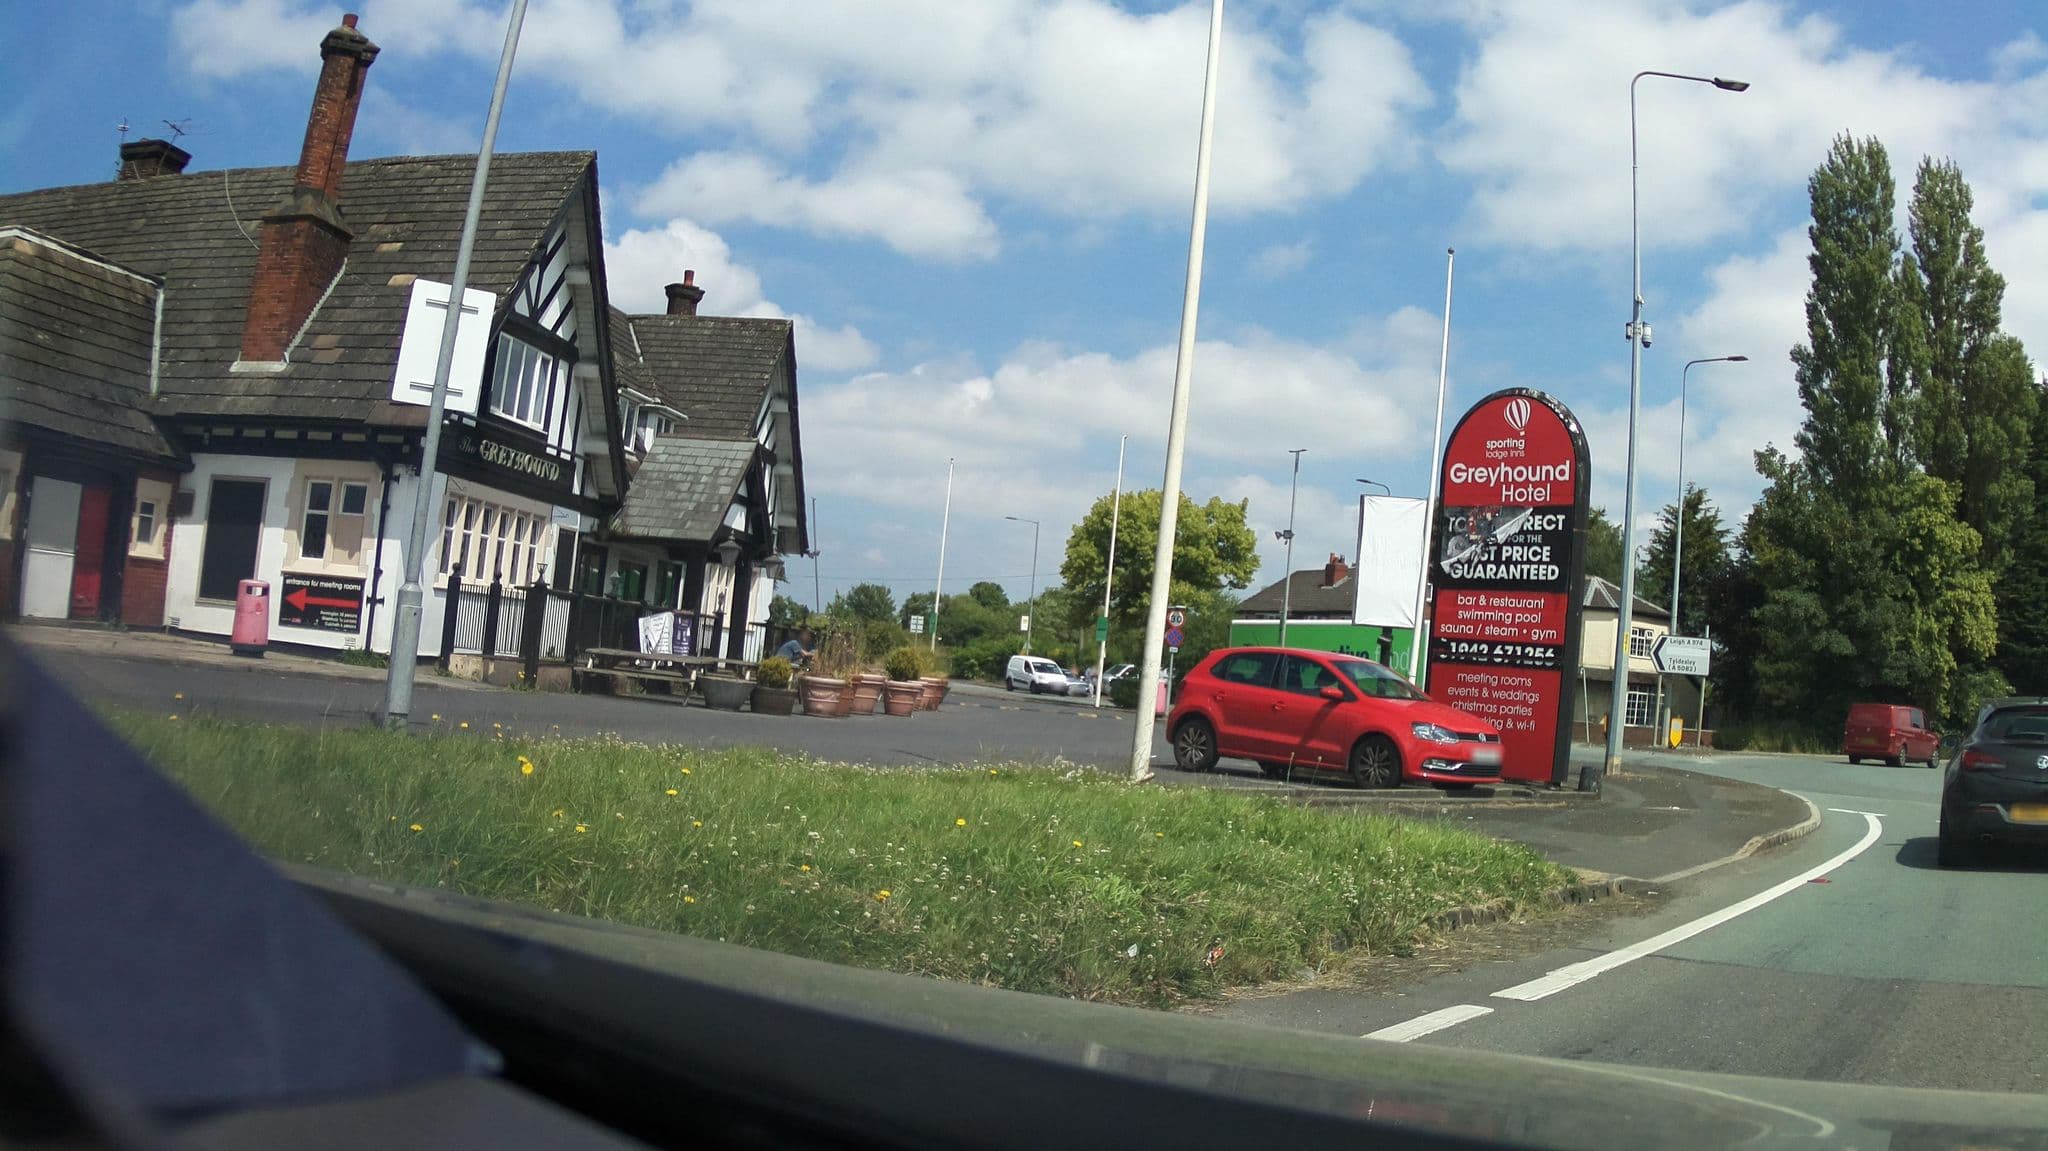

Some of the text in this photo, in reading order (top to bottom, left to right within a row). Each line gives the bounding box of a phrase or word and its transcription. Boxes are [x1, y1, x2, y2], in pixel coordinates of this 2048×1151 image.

[1486, 438, 1525, 450] sporting
[480, 439, 560, 481] GREYHOUND
[1485, 449, 1525, 459] lodge inns
[1450, 460, 1570, 487] Greyhound
[1501, 483, 1551, 502] Hotel
[1523, 514, 1566, 531] RECT
[1527, 534, 1543, 543] THE
[1501, 546, 1551, 561] PRICE
[1450, 562, 1560, 581] GUARANTEED
[285, 578, 310, 586] entrance
[319, 581, 342, 590] meeting
[1457, 594, 1545, 609] bar & restaurant
[1457, 609, 1541, 624] swimming pool
[1440, 623, 1474, 634] sauna
[1484, 625, 1519, 637] steam
[1531, 628, 1557, 641] gym
[1457, 672, 1532, 687] meeting rooms
[1447, 686, 1540, 704] events & weddings
[1451, 700, 1533, 717] christmas parties
[1506, 719, 1514, 729] &
[1516, 720, 1536, 732] wi-fi
